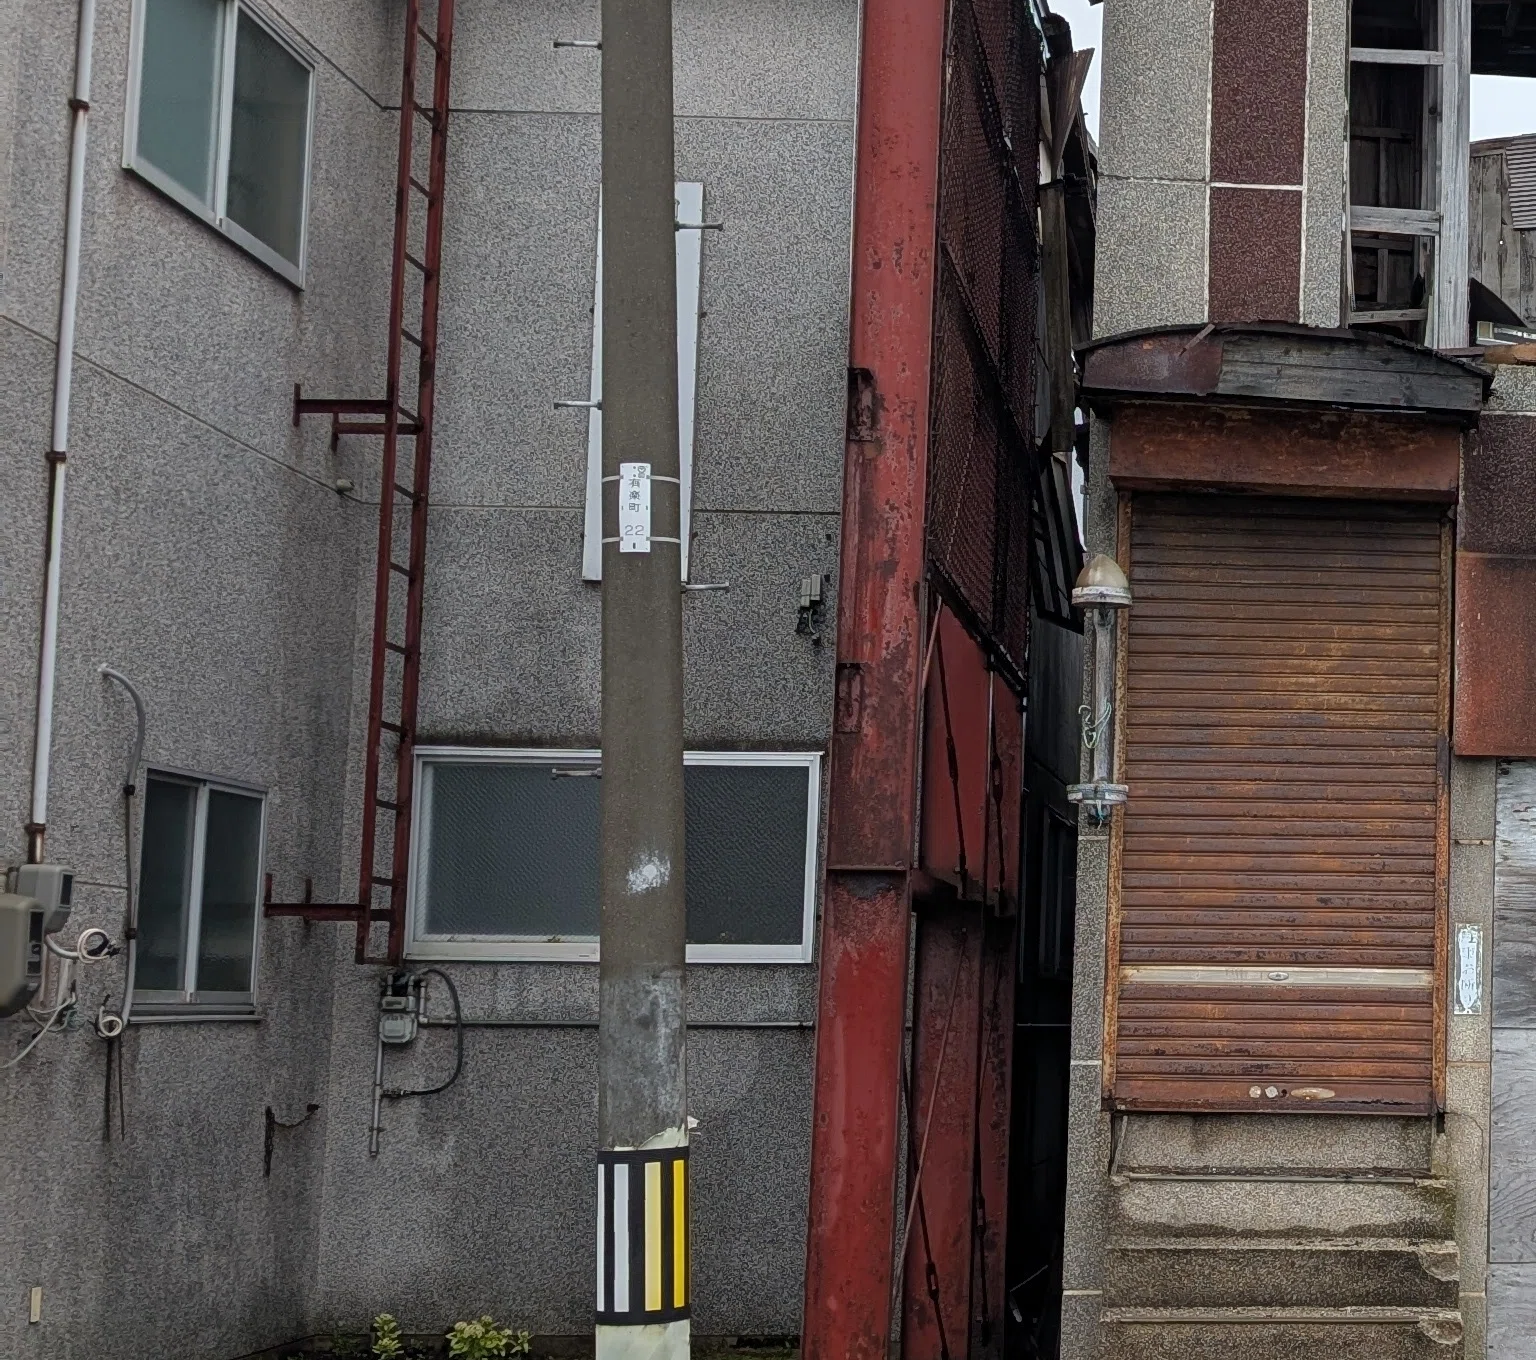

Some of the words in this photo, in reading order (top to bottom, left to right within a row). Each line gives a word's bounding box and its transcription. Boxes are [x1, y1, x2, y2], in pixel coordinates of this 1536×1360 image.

[628, 478, 641, 513] 有楽町
[624, 524, 645, 536] 22
